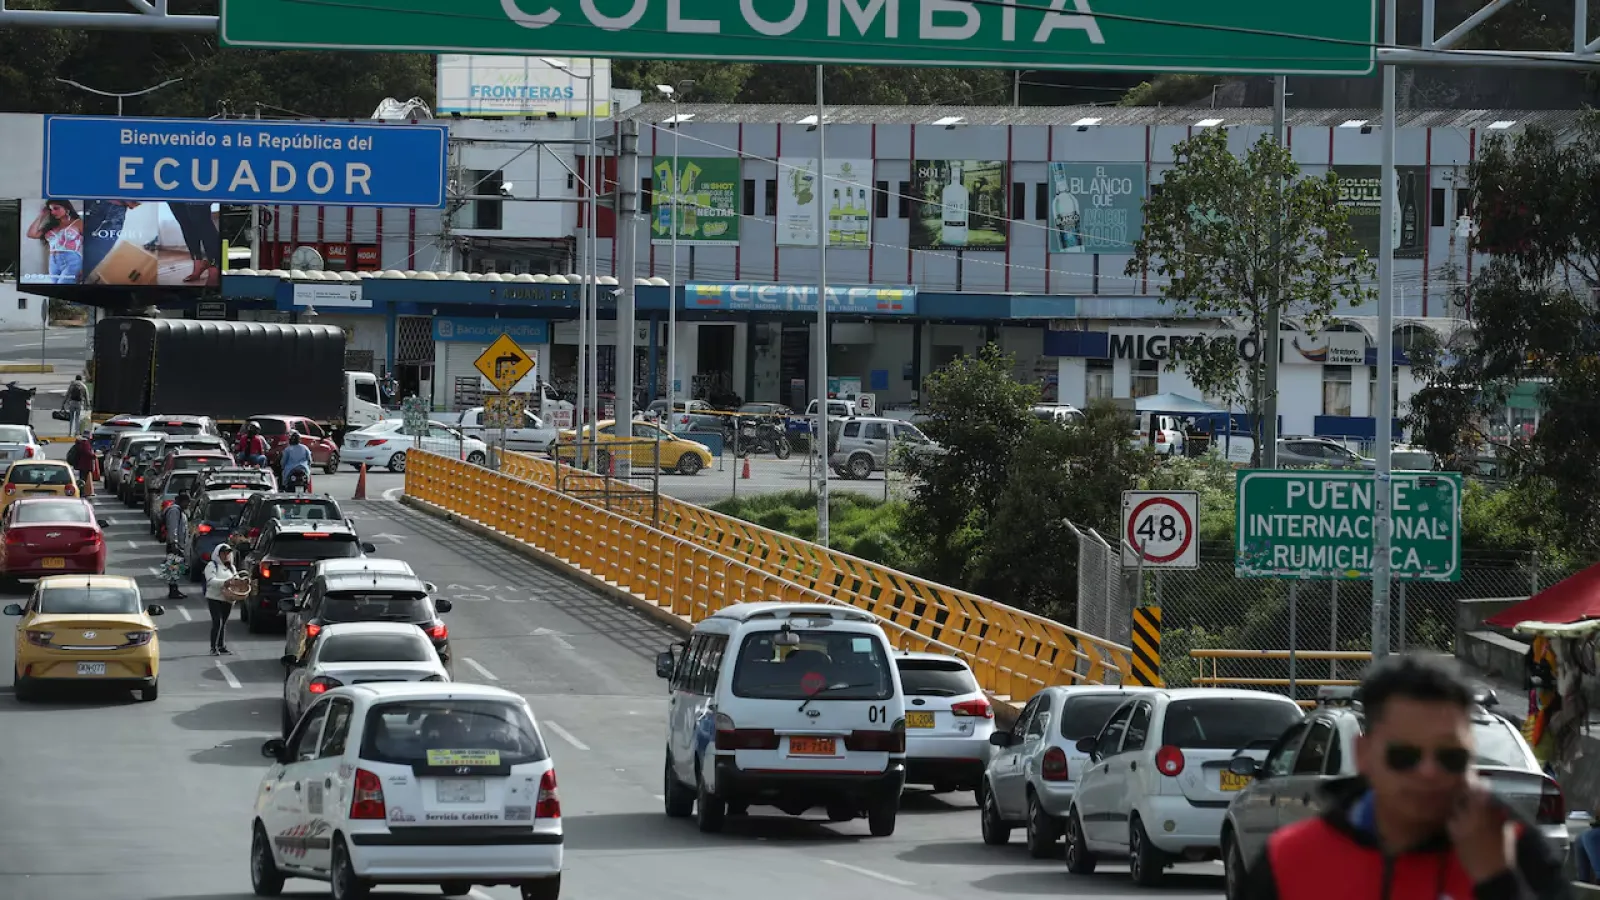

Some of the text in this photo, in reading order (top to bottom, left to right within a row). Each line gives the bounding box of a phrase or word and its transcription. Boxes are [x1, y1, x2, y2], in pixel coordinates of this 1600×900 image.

[471, 84, 574, 99] FRONTERAS
[120, 129, 372, 151] Bienvenido a la República del
[118, 156, 372, 195] ECUADOR
[918, 167, 939, 178] 801
[1096, 166, 1107, 177] EL
[1070, 177, 1132, 195] BLANCO
[1338, 178, 1381, 187] GOLDEN
[1092, 194, 1113, 208] QUE
[1338, 187, 1381, 201] BULL
[697, 208, 735, 217] NECTAR
[328, 246, 346, 256] SALE
[730, 284, 878, 308] CENAF
[456, 324, 486, 335] Banco
[1109, 332, 1284, 363] MIGRACIÓ
[861, 398, 870, 408] E
[1286, 481, 1411, 511] PUENE
[1137, 514, 1176, 542] 48
[1250, 514, 1447, 540] INTERNACINAL
[868, 705, 886, 723] 01
[905, 714, 934, 723] IL-208
[426, 812, 458, 820] Servicio
[462, 812, 498, 820] Colectivo
